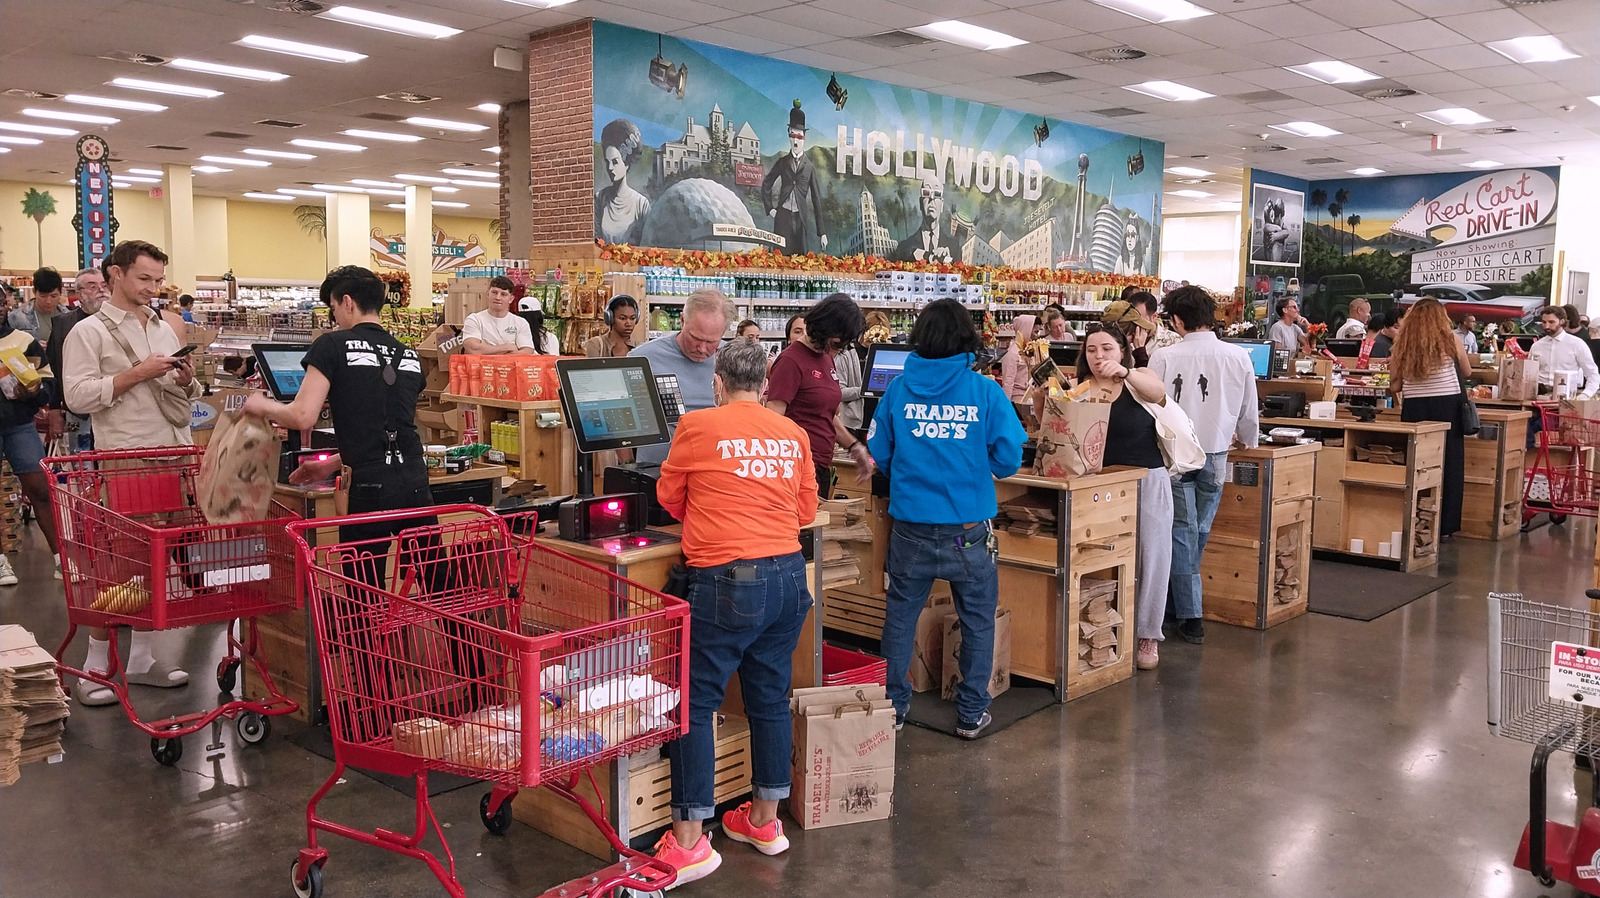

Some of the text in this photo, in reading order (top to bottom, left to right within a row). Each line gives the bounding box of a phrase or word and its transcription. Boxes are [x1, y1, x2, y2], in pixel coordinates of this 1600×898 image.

[836, 125, 1043, 201] HOLLYWOOD
[88, 162, 103, 204] NEW
[1425, 172, 1534, 225] Red Cart
[1028, 214, 1048, 231] HOTEL
[1466, 200, 1539, 238] DRIVE-IN
[440, 246, 456, 255] DELI
[1436, 239, 1518, 258] Now Showing:
[1417, 248, 1545, 272] A SHOPPING CART
[1422, 268, 1517, 283] NAMED DESIRE
[438, 335, 463, 354] TOTE
[903, 403, 979, 422] TRADER
[911, 421, 969, 440] JOE'S
[716, 438, 802, 459] TRADER
[733, 458, 795, 479] JOE'S
[1558, 651, 1600, 667] IN-STO
[1558, 668, 1573, 676] FOR
[1576, 671, 1591, 679] OUR
[812, 748, 823, 825] TRADER JOE'S
